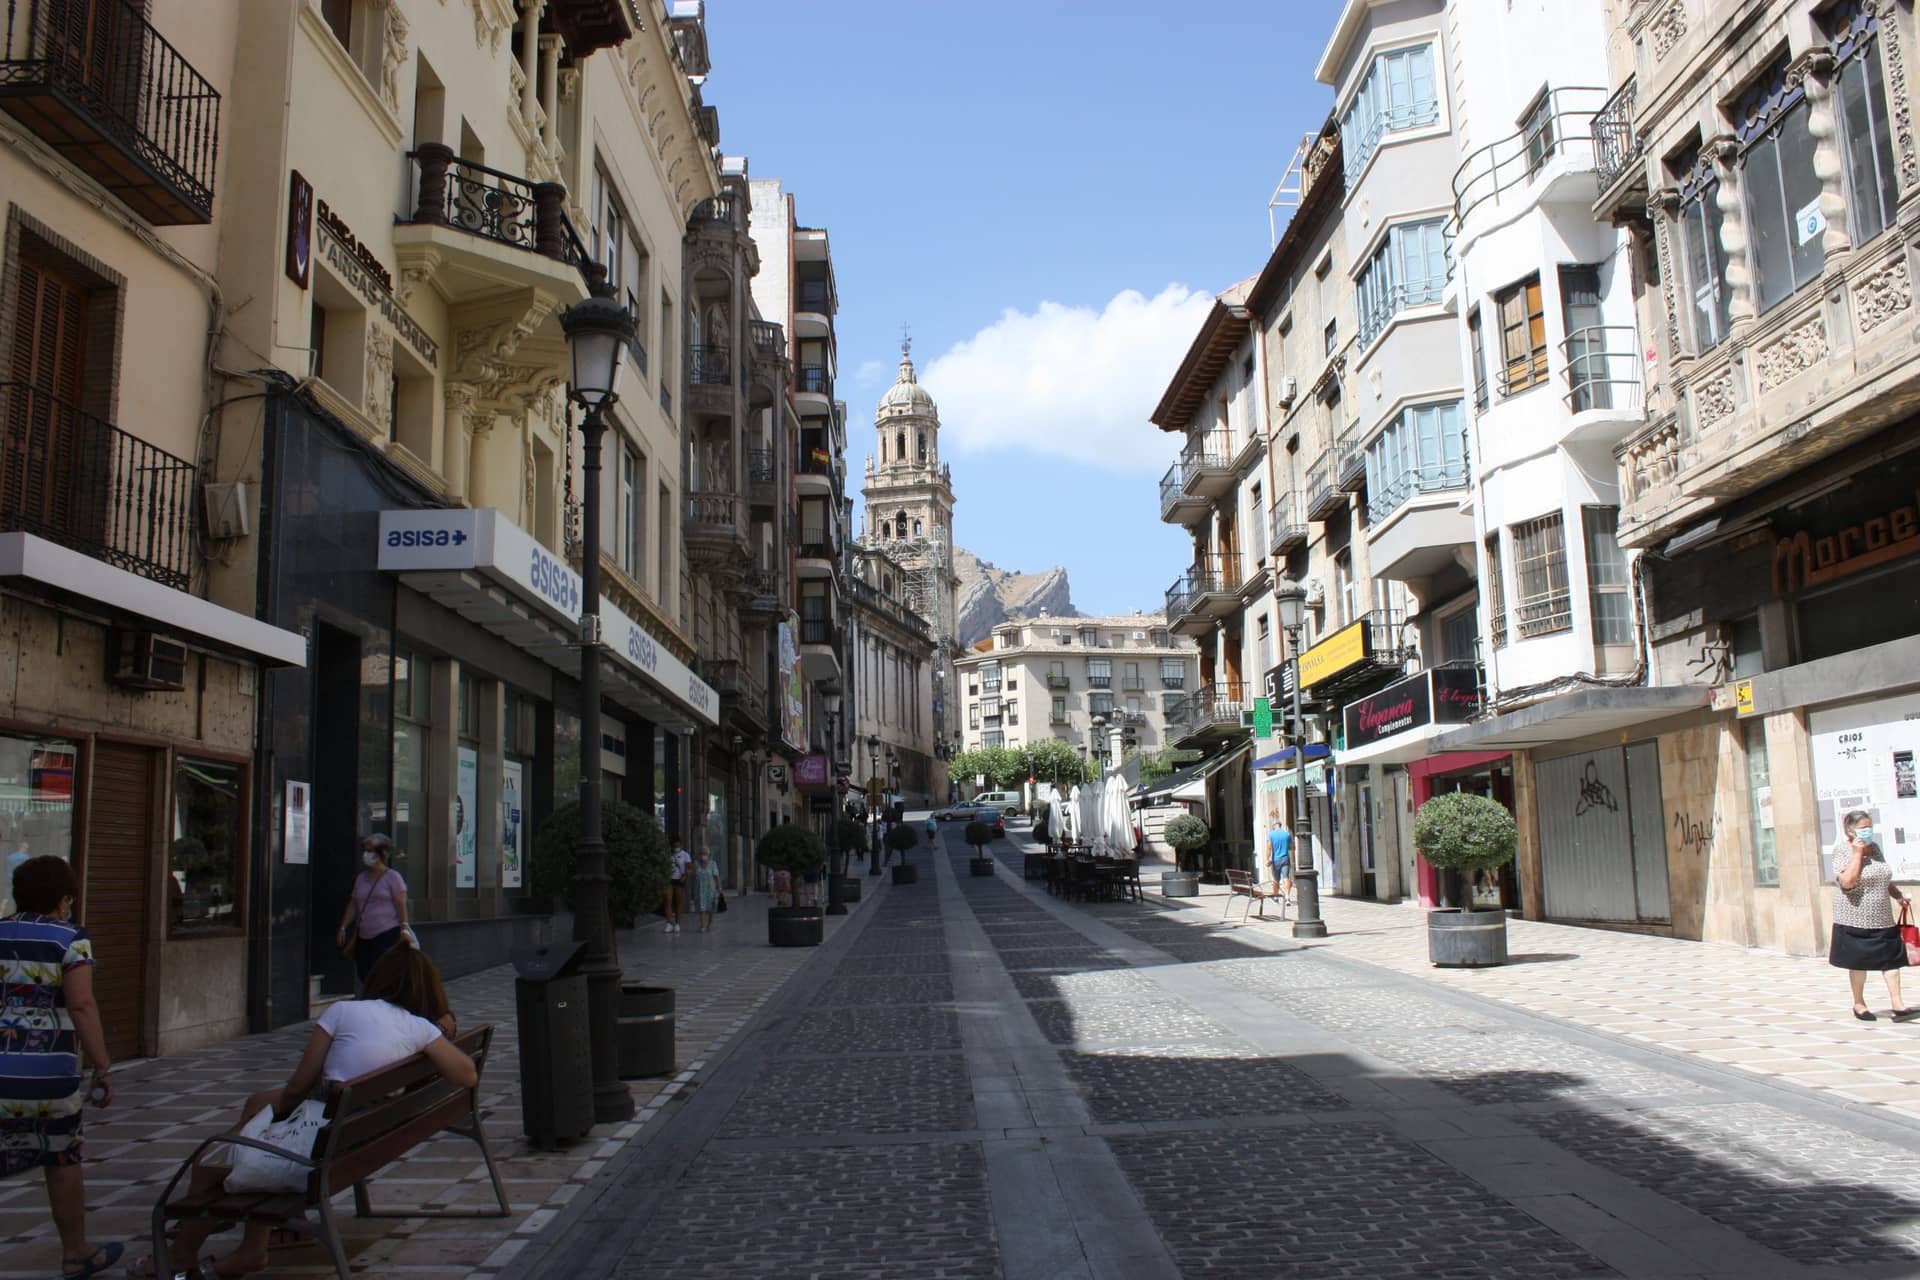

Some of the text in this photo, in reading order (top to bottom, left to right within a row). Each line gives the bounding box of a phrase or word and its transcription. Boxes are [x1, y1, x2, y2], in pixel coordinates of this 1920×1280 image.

[316, 228, 438, 369] VARGAS-MACHUCA
[387, 530, 449, 547] asisa
[531, 547, 569, 608] asisa
[628, 626, 652, 670] asisa
[1358, 693, 1413, 739] Elegancia
[1378, 715, 1413, 735] Complementos
[1838, 732, 1863, 744] CRIOS
